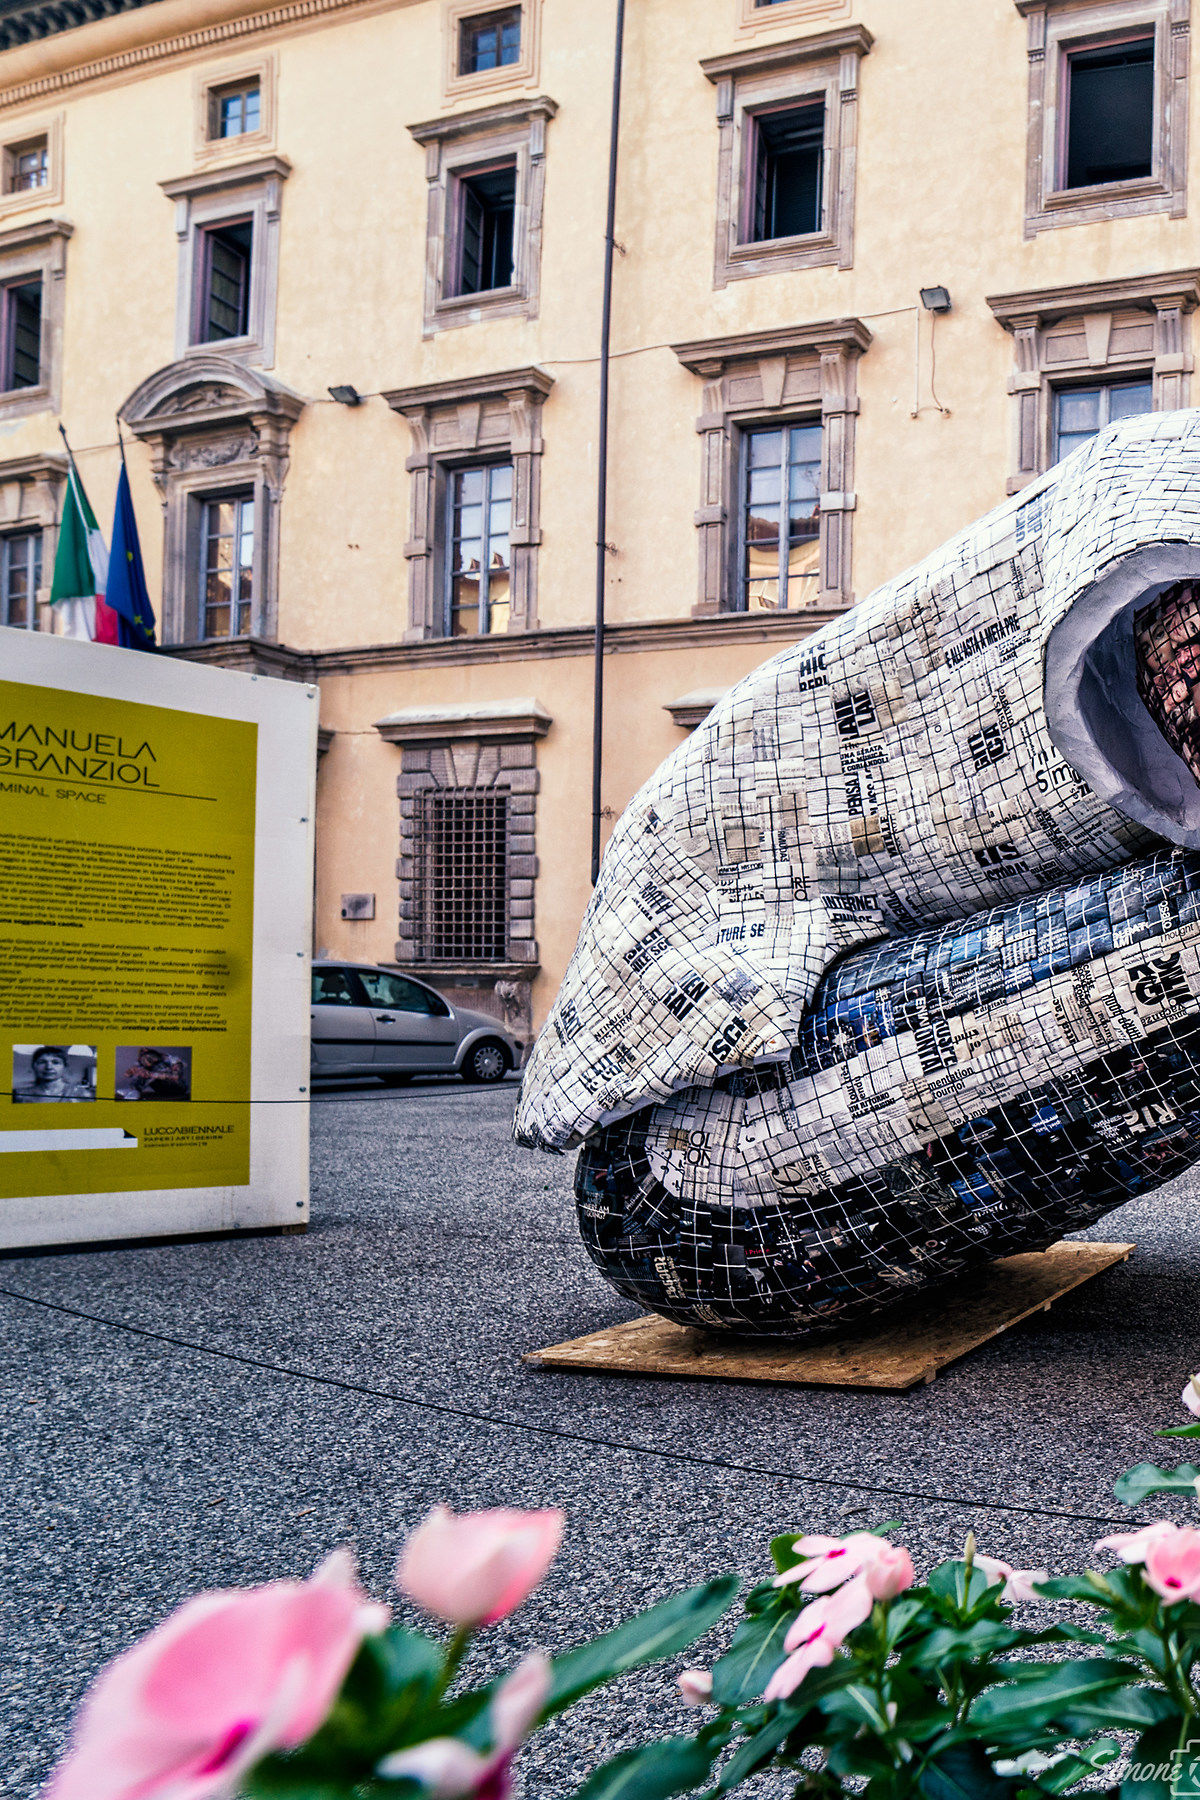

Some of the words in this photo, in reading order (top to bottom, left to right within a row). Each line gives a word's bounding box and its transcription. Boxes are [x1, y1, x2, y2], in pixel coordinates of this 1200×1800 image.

[56, 788, 107, 805] SPACE
[822, 894, 880, 911] INTERNET
[1159, 900, 1173, 932] osato
[1083, 964, 1096, 990] CAUSE
[1142, 1004, 1187, 1027] vacanza
[927, 1066, 976, 1090] mentation
[861, 1092, 890, 1109] RITORNO
[144, 1125, 235, 1135] LUCCABIENNALE
